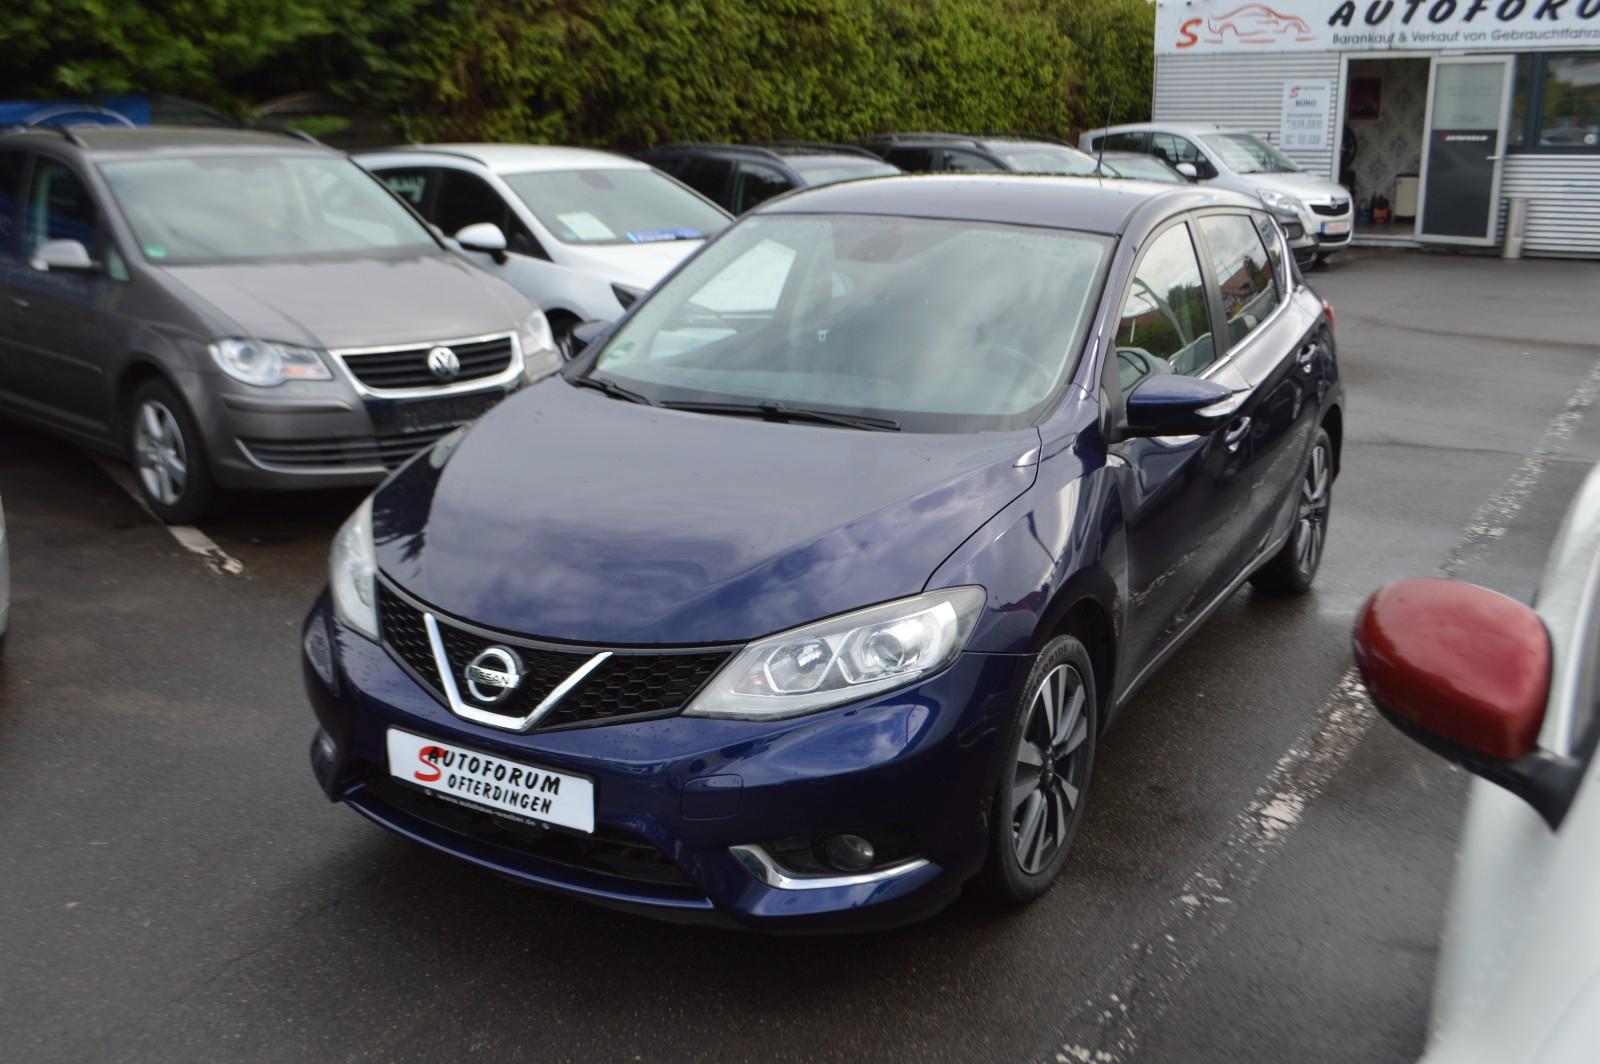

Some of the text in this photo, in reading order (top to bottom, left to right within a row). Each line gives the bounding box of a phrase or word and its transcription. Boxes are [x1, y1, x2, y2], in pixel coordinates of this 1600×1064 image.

[1175, 18, 1202, 48] S
[1332, 32, 1395, 45] Barankauf
[1399, 32, 1408, 42] &
[1412, 30, 1460, 43] Verkauf
[1463, 31, 1487, 41] von
[470, 668, 511, 686] SSAN
[428, 746, 561, 796] AUTOFORUM
[447, 774, 553, 815] OFTERDINGEN
